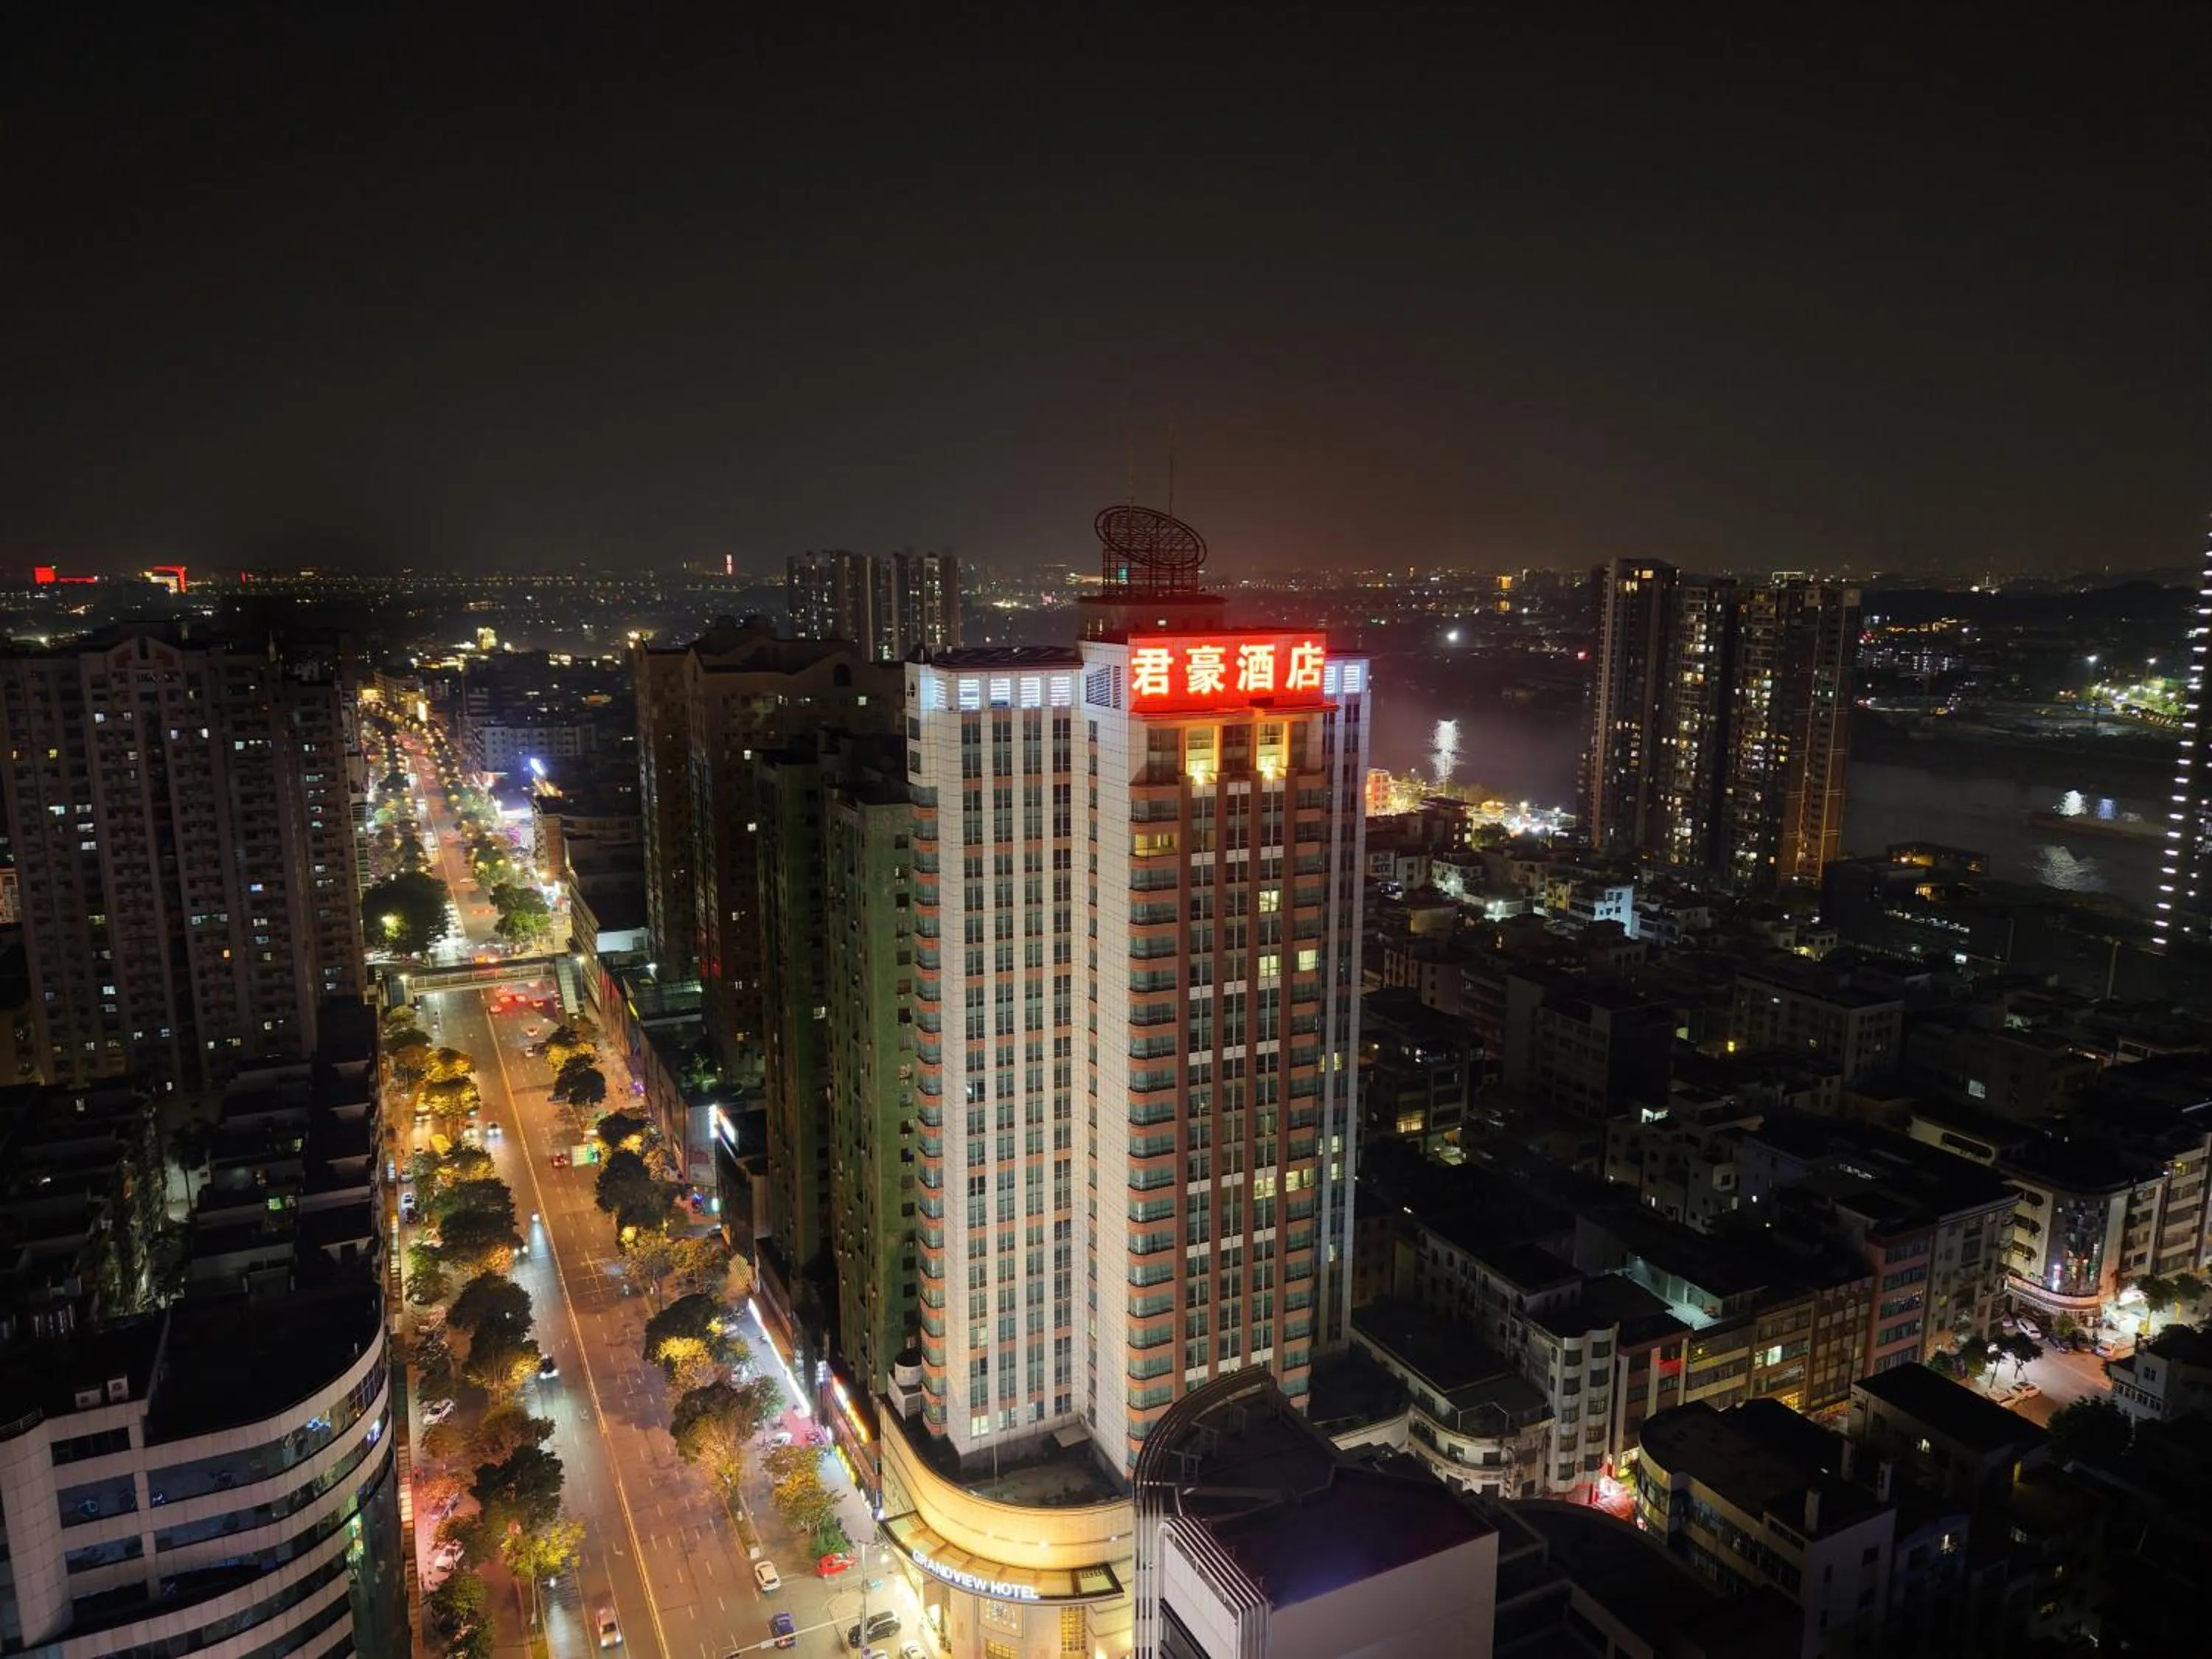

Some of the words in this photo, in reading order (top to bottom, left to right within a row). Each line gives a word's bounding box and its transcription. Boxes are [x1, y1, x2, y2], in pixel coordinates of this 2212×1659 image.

[1131, 641, 1325, 695] 君豪酒店
[912, 1549, 987, 1591] GRANDVIEW
[991, 1580, 1039, 1599] HOTEL
